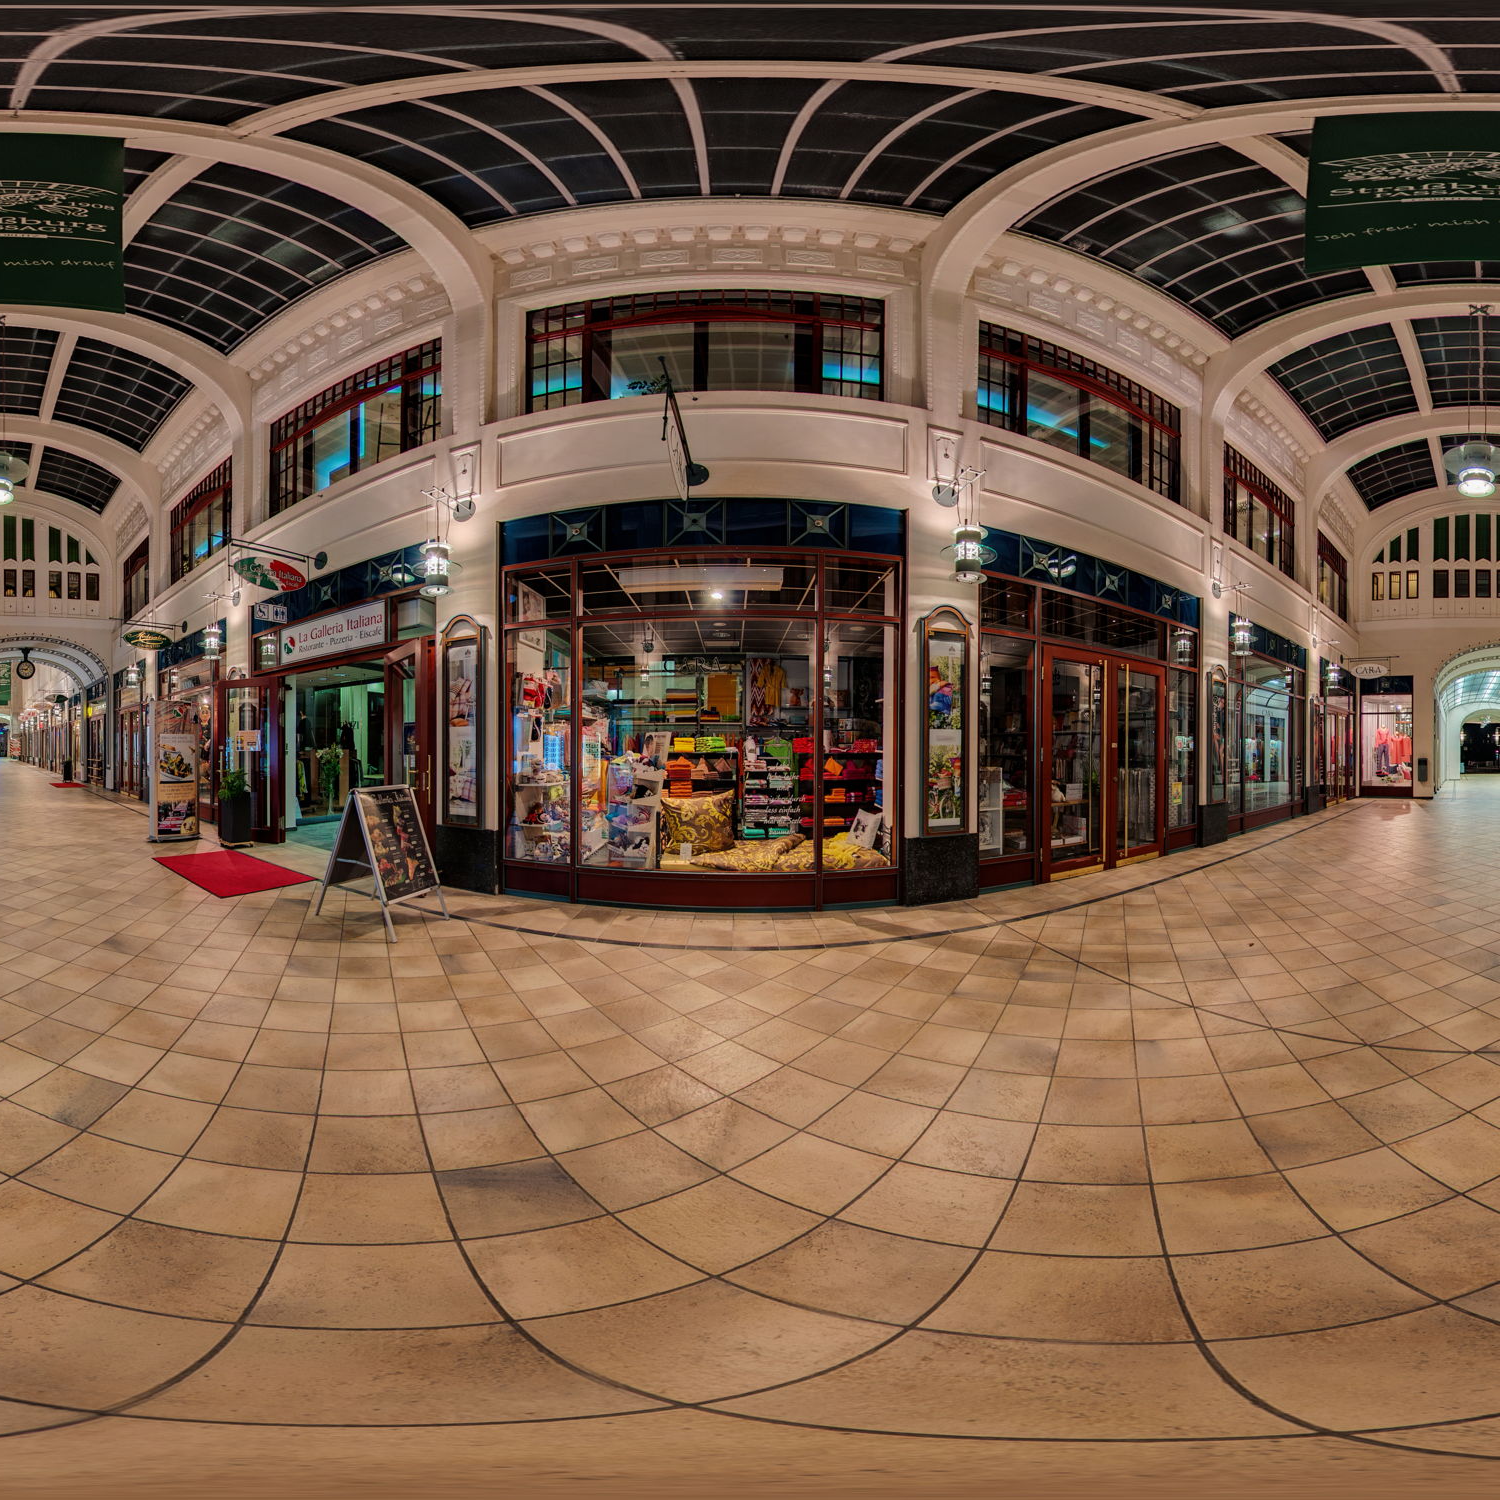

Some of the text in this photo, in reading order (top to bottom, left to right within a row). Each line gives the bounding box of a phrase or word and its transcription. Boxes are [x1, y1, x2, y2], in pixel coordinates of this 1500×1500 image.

[69, 200, 116, 211] 1908
[3, 258, 55, 267] mich
[60, 259, 117, 270] drauf
[299, 613, 383, 643] La Galleria Italiana
[298, 641, 325, 653] Ristorante
[329, 635, 353, 646] Pizzeria
[1355, 665, 1382, 674] CARA
